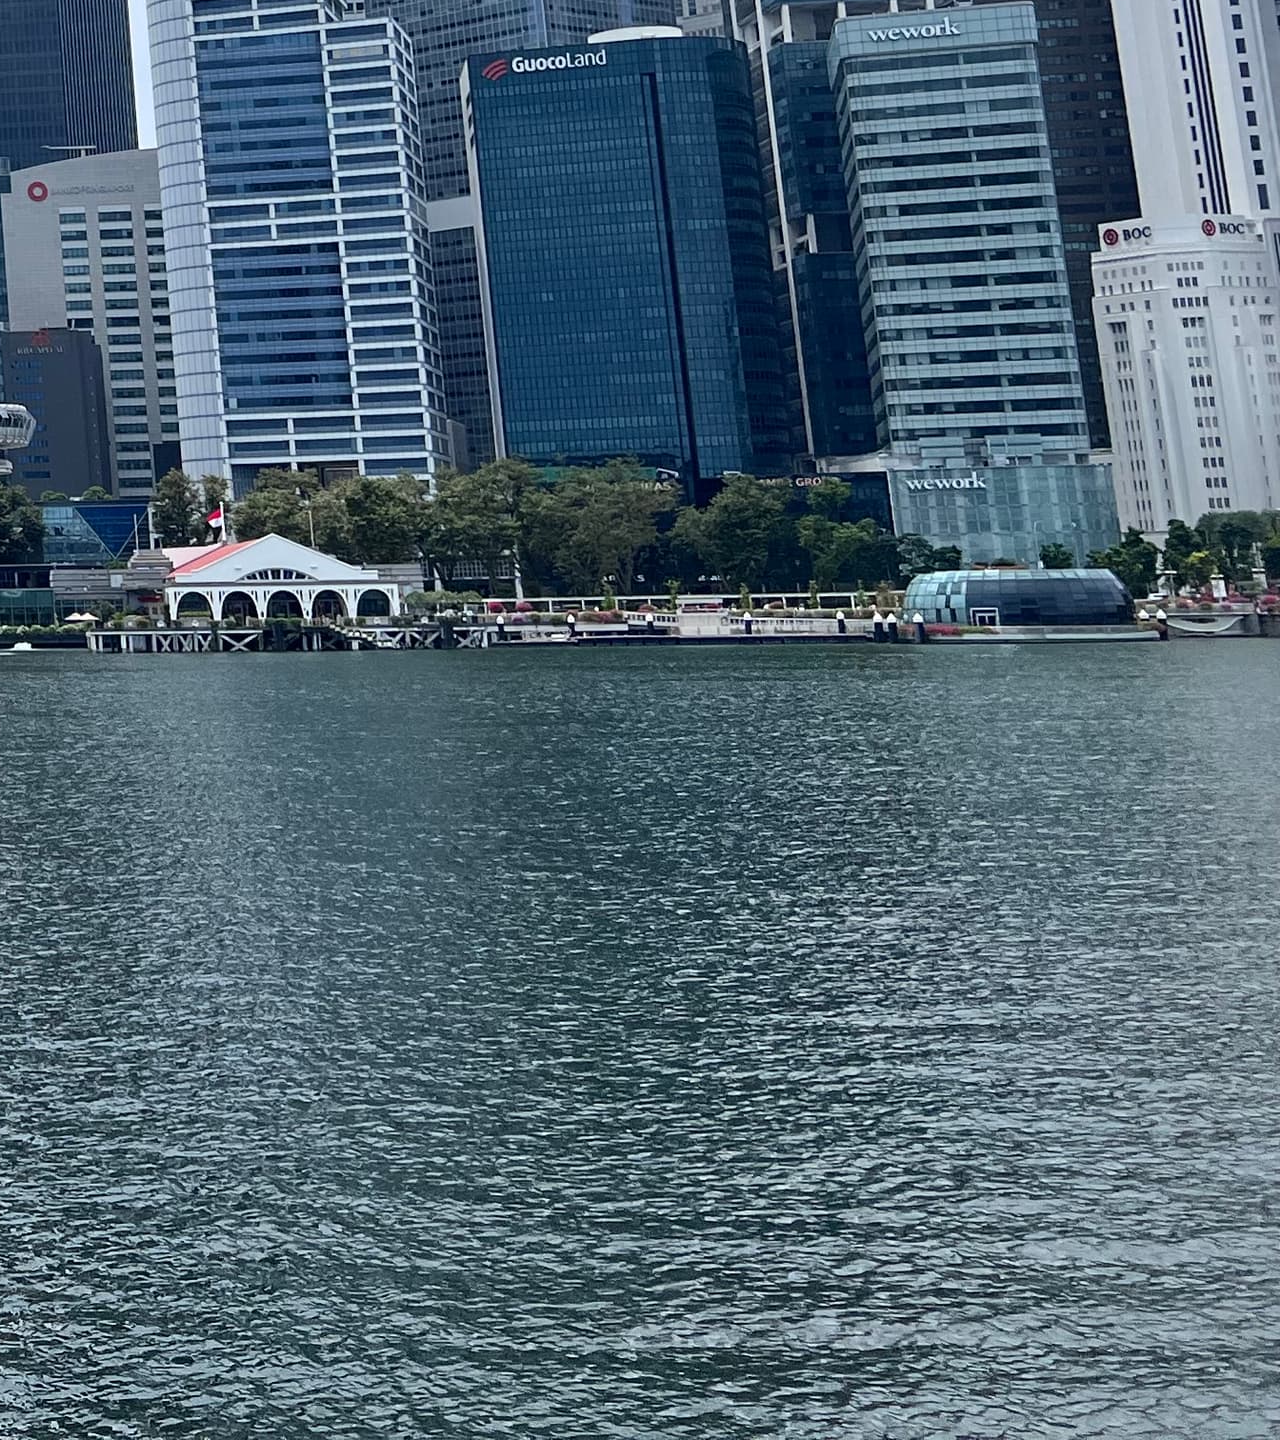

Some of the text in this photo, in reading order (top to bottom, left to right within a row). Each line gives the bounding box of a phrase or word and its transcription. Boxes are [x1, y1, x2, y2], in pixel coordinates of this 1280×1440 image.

[868, 16, 961, 41] wework
[511, 49, 607, 73] GuocoLand
[1122, 226, 1152, 241] BOC
[1218, 222, 1246, 234] BOC
[905, 471, 987, 491] wework
